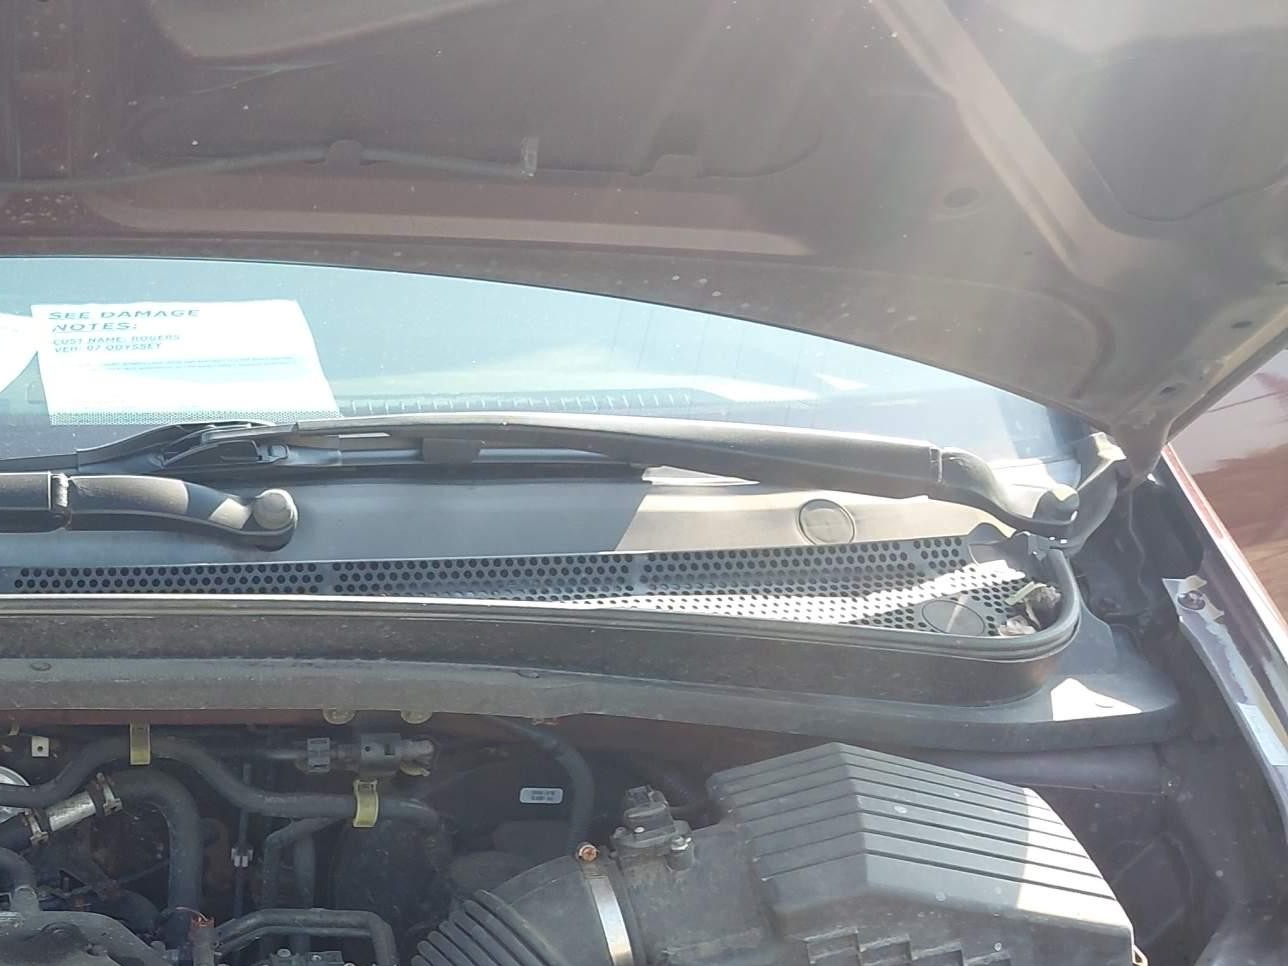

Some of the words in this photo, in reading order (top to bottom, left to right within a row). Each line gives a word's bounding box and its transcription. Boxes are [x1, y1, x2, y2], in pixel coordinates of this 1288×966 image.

[48, 311, 90, 320] SEE
[100, 309, 201, 319] DAMAGE
[52, 322, 137, 333] NOTES:
